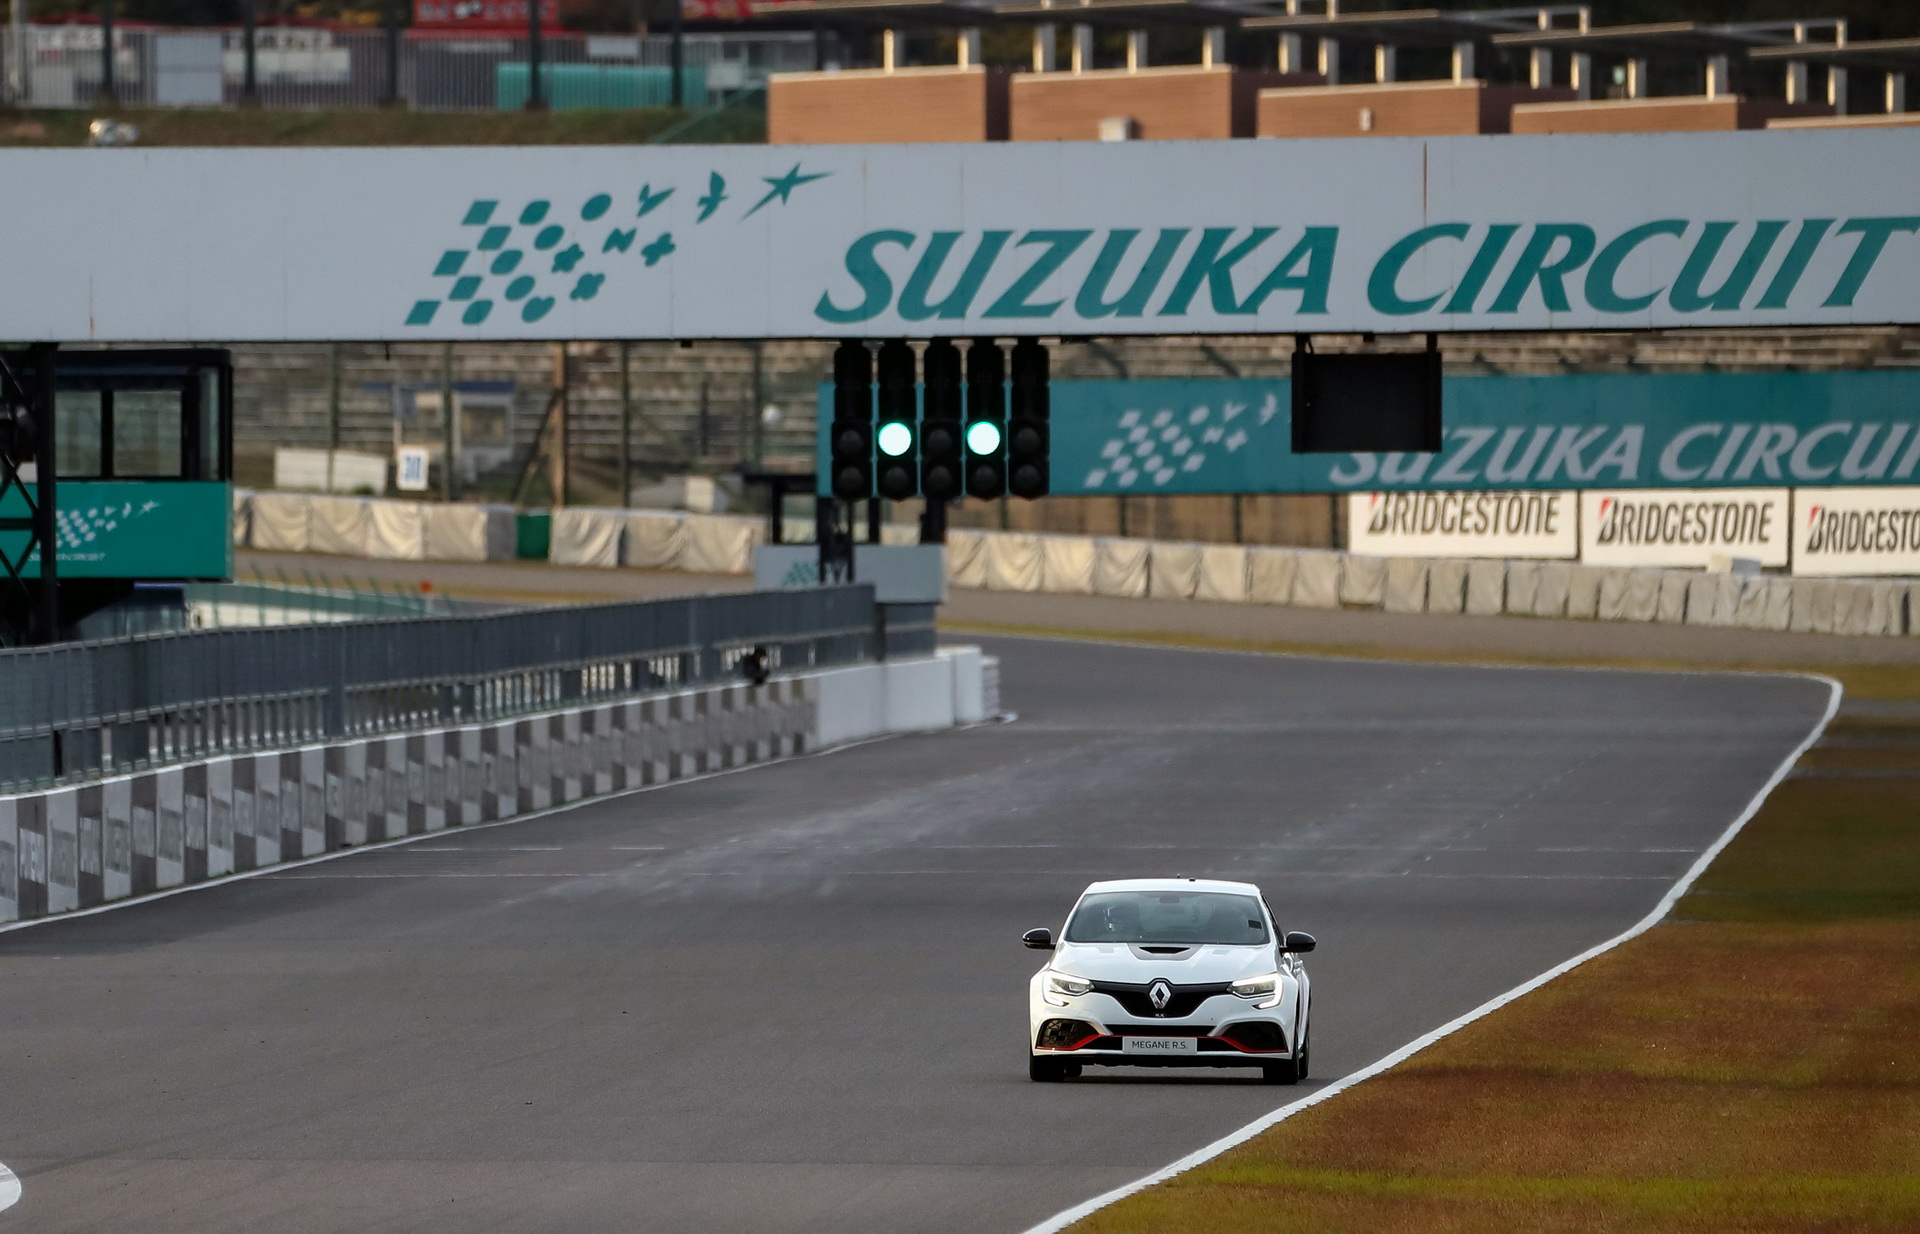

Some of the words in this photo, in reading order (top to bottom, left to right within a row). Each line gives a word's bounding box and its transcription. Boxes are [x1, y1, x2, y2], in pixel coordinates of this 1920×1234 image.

[814, 226, 1340, 324] SUZUKA
[1366, 217, 1920, 316] CIRCUIT
[1367, 491, 1561, 536] BRIDGESTONE
[1597, 497, 1775, 545] BRIDGESTONE
[1131, 1041, 1170, 1049] MEGANE
[1172, 1042, 1189, 1050] R.S.
